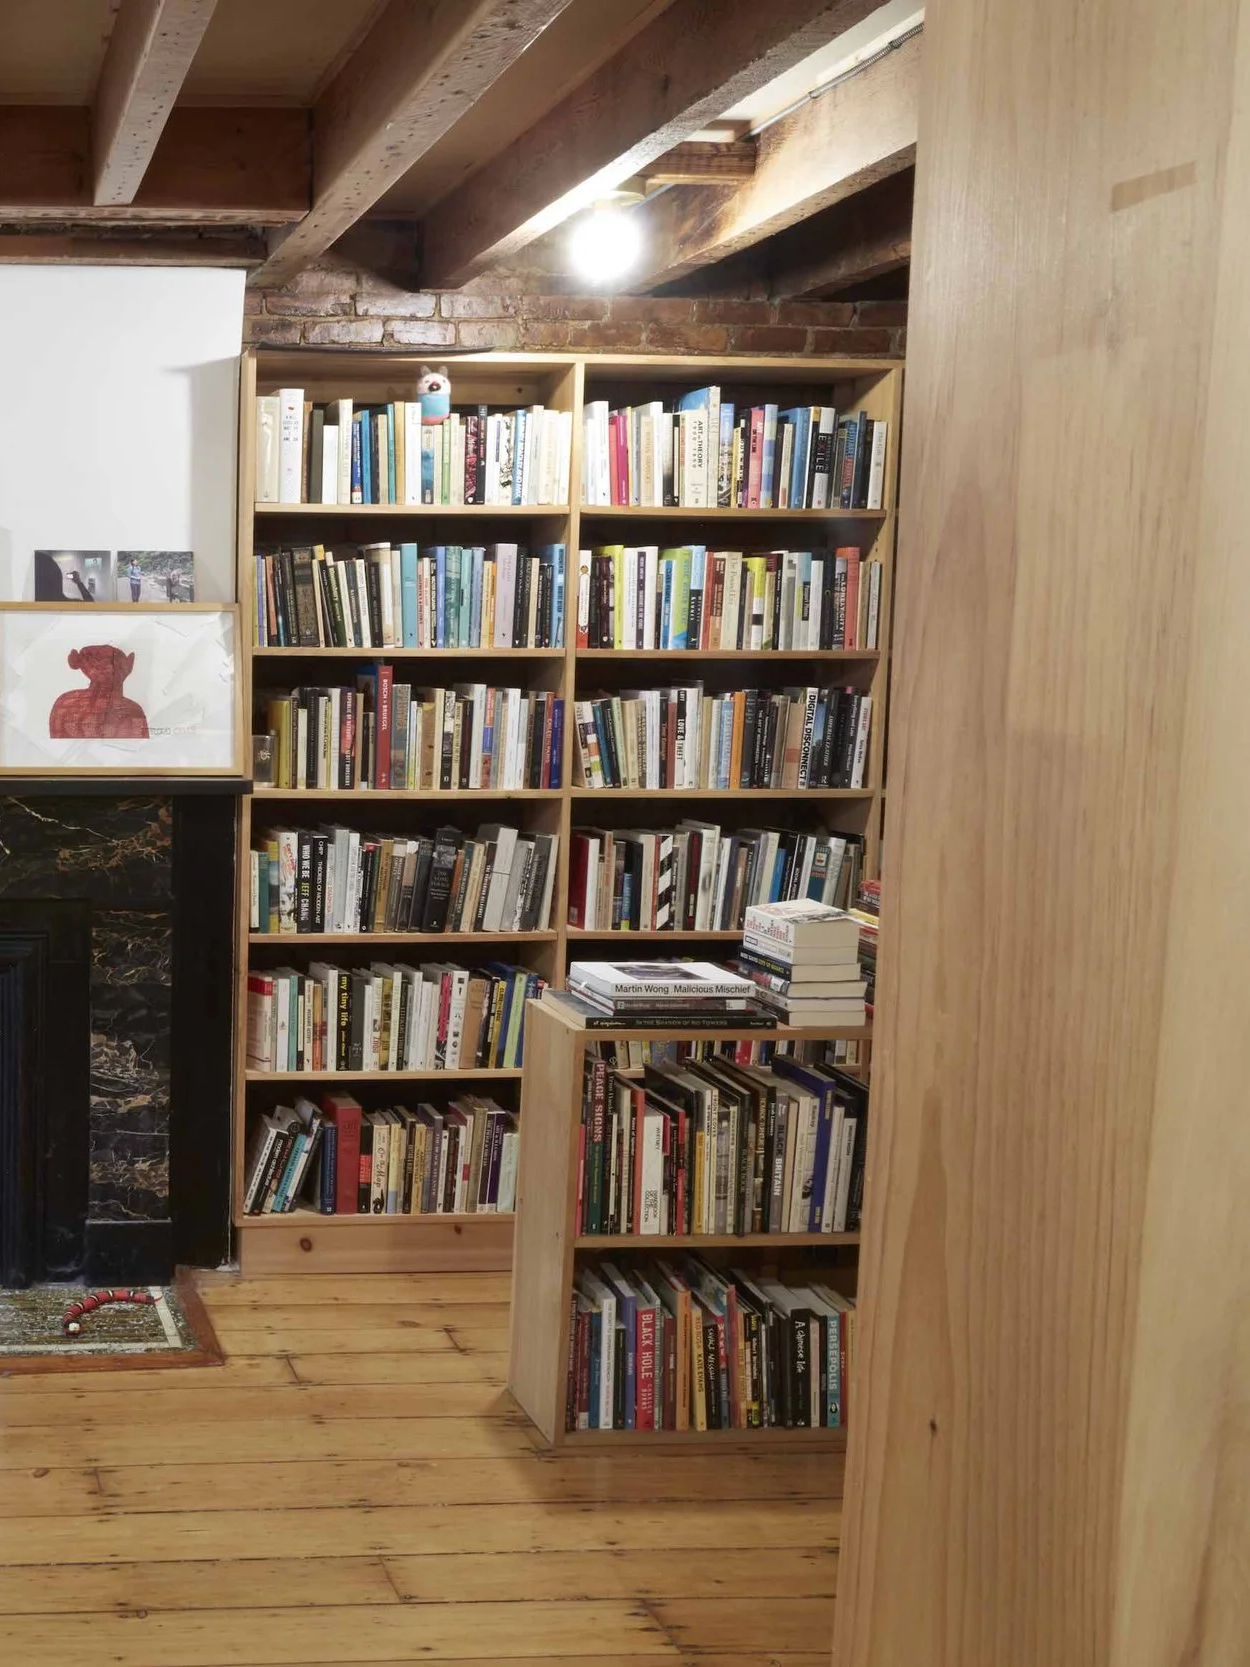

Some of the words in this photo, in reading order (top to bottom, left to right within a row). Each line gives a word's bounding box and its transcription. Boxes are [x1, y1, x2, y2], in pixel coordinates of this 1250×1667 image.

[816, 435, 826, 470] EXILE
[806, 695, 816, 726] DIGITAL
[800, 728, 812, 780] DISCONNECT
[302, 845, 310, 858] WHO
[302, 860, 310, 870] WE
[302, 882, 310, 896] JEFF
[301, 899, 309, 920] CHANG
[340, 976, 347, 989] my
[615, 984, 643, 993] Martin
[644, 985, 669, 995] Wong
[674, 984, 713, 994] Malicious
[715, 984, 750, 994] Mischief
[340, 992, 348, 1009] tiny
[596, 1064, 605, 1100] PEACE
[594, 1105, 603, 1142] SIGNS
[274, 1139, 283, 1158] modern
[776, 1124, 784, 1155] BLACK
[774, 1158, 782, 1196] BRITAIN
[641, 1314, 653, 1347] BLACK
[641, 1352, 652, 1379] HOLE
[829, 1320, 837, 1389] PERSEPOLIS
